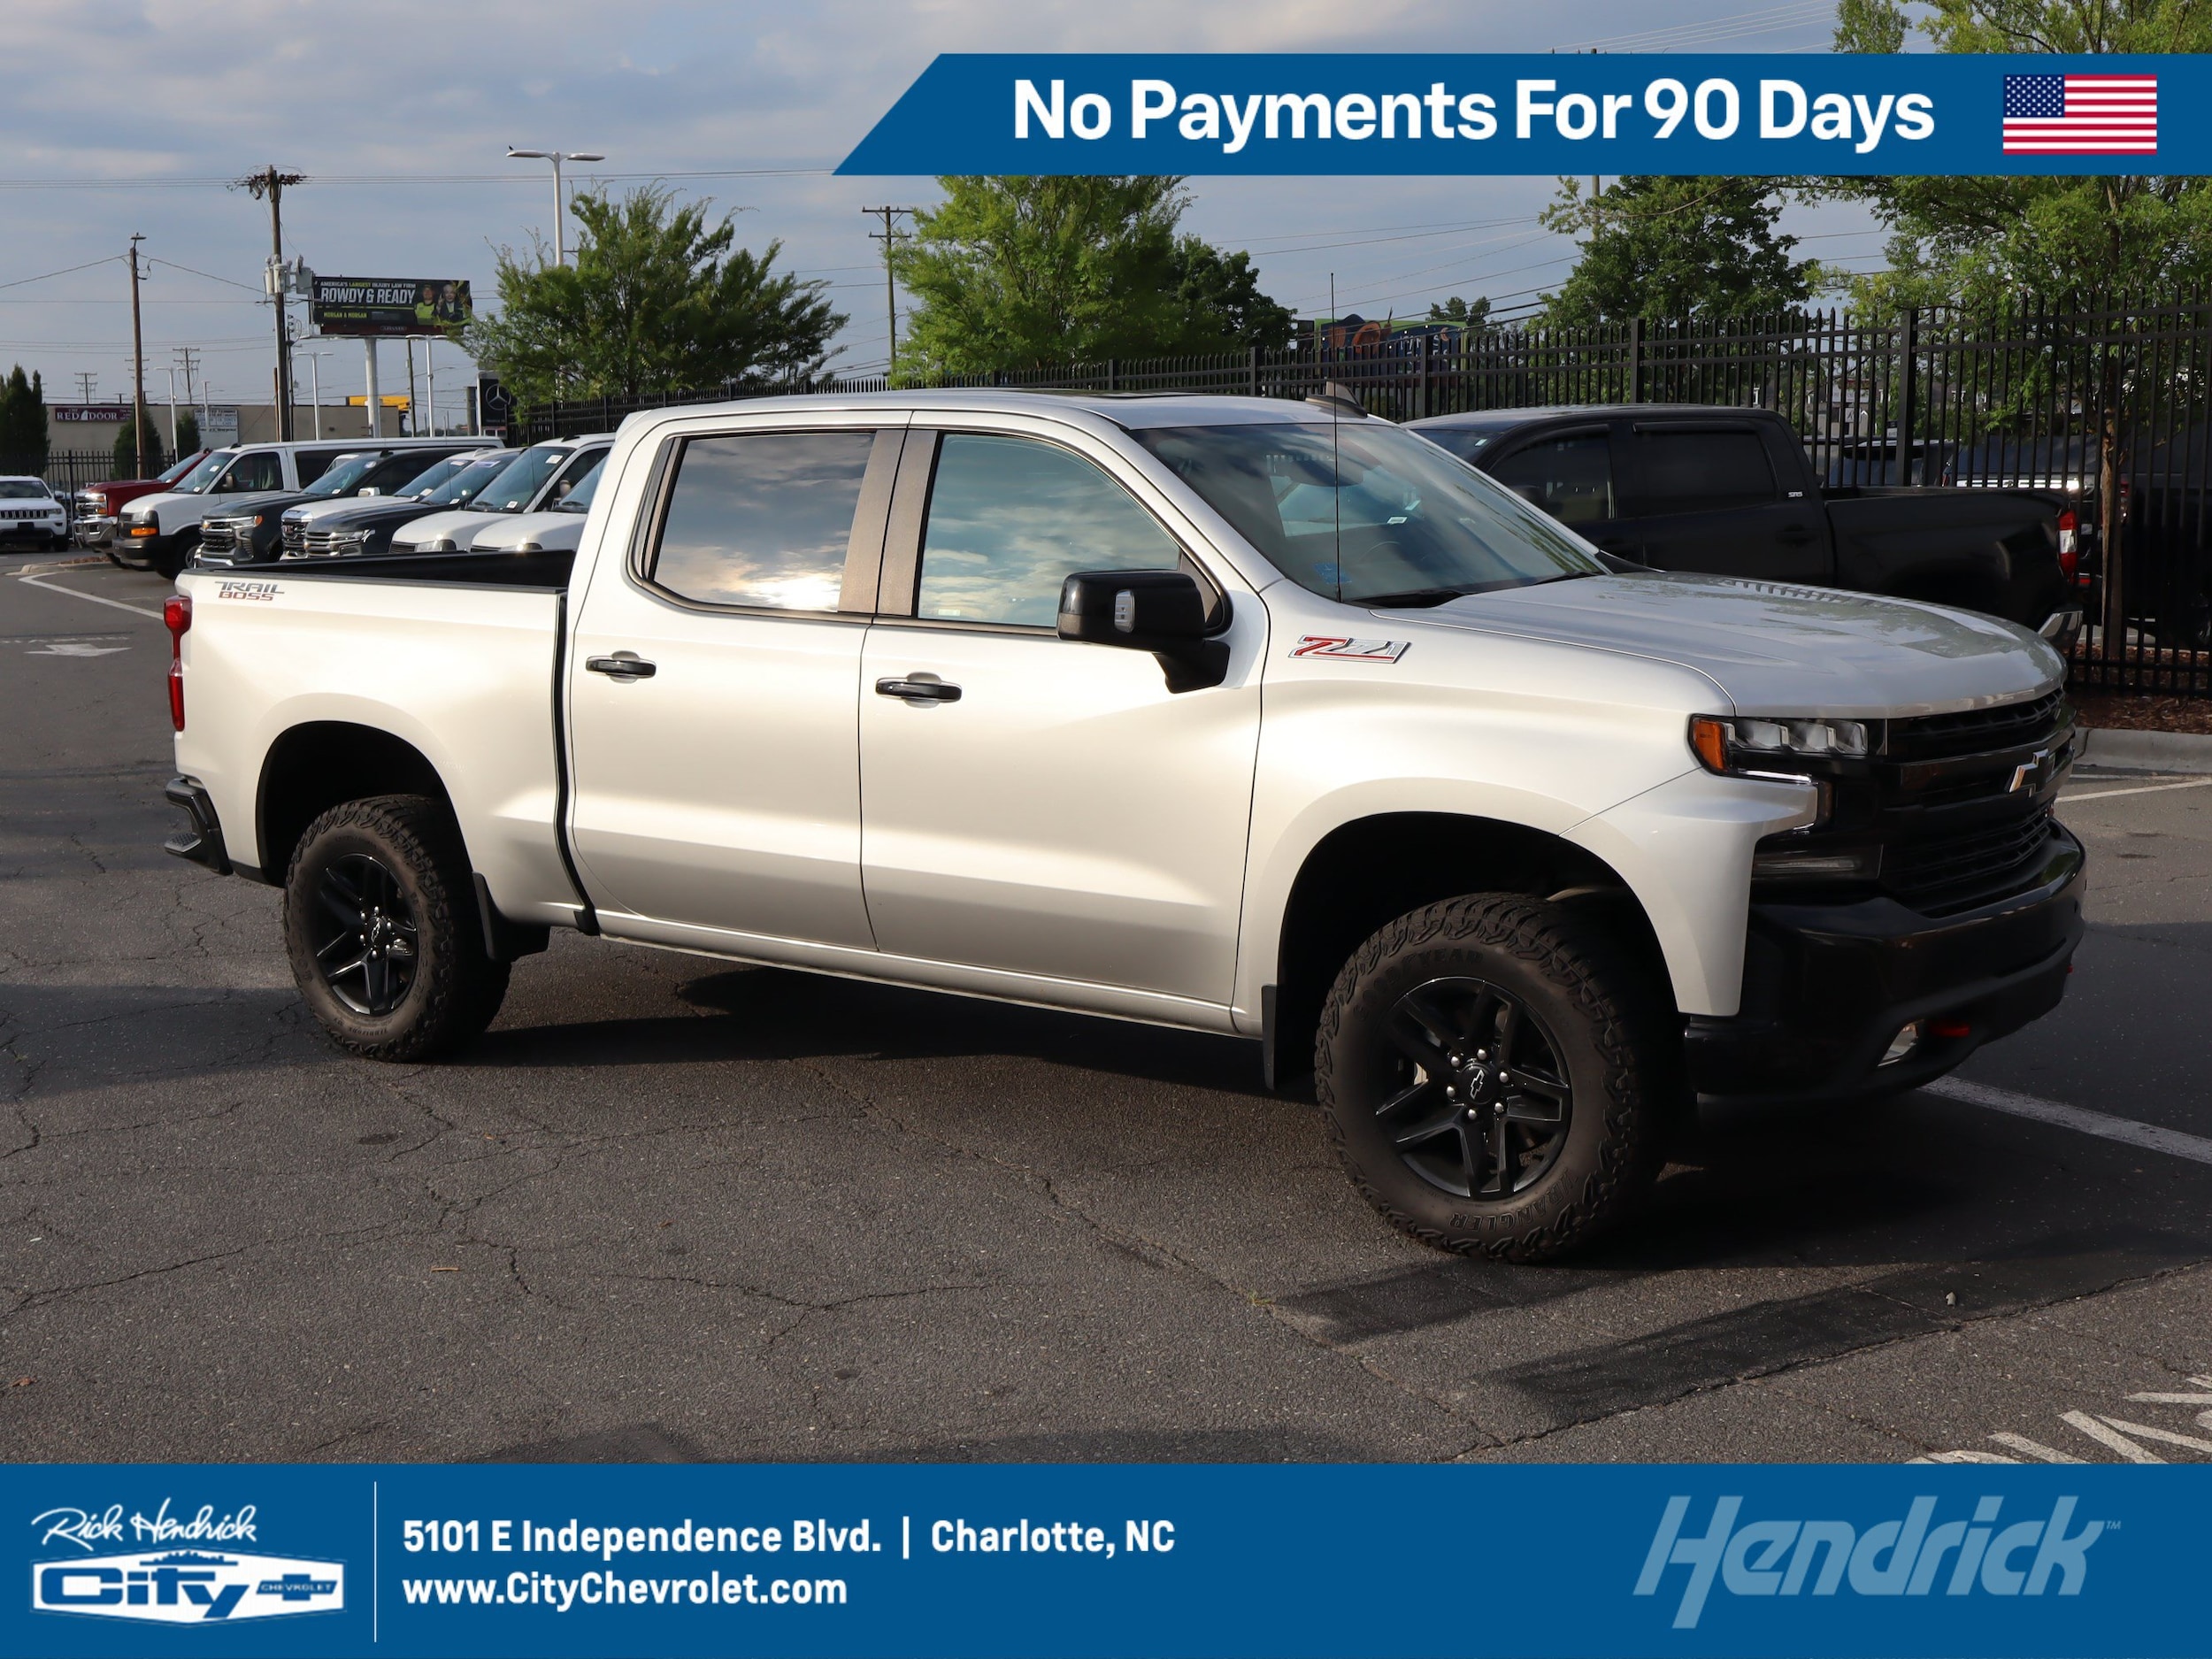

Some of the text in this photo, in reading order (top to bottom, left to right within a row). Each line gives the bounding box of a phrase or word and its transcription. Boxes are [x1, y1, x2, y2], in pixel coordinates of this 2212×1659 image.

[320, 288, 416, 304] ROWDY & READY
[214, 580, 285, 595] TRAIL
[219, 591, 275, 602] BOSS
[1288, 634, 1411, 664] Z71
[1448, 1167, 1579, 1233] WRANGLER
